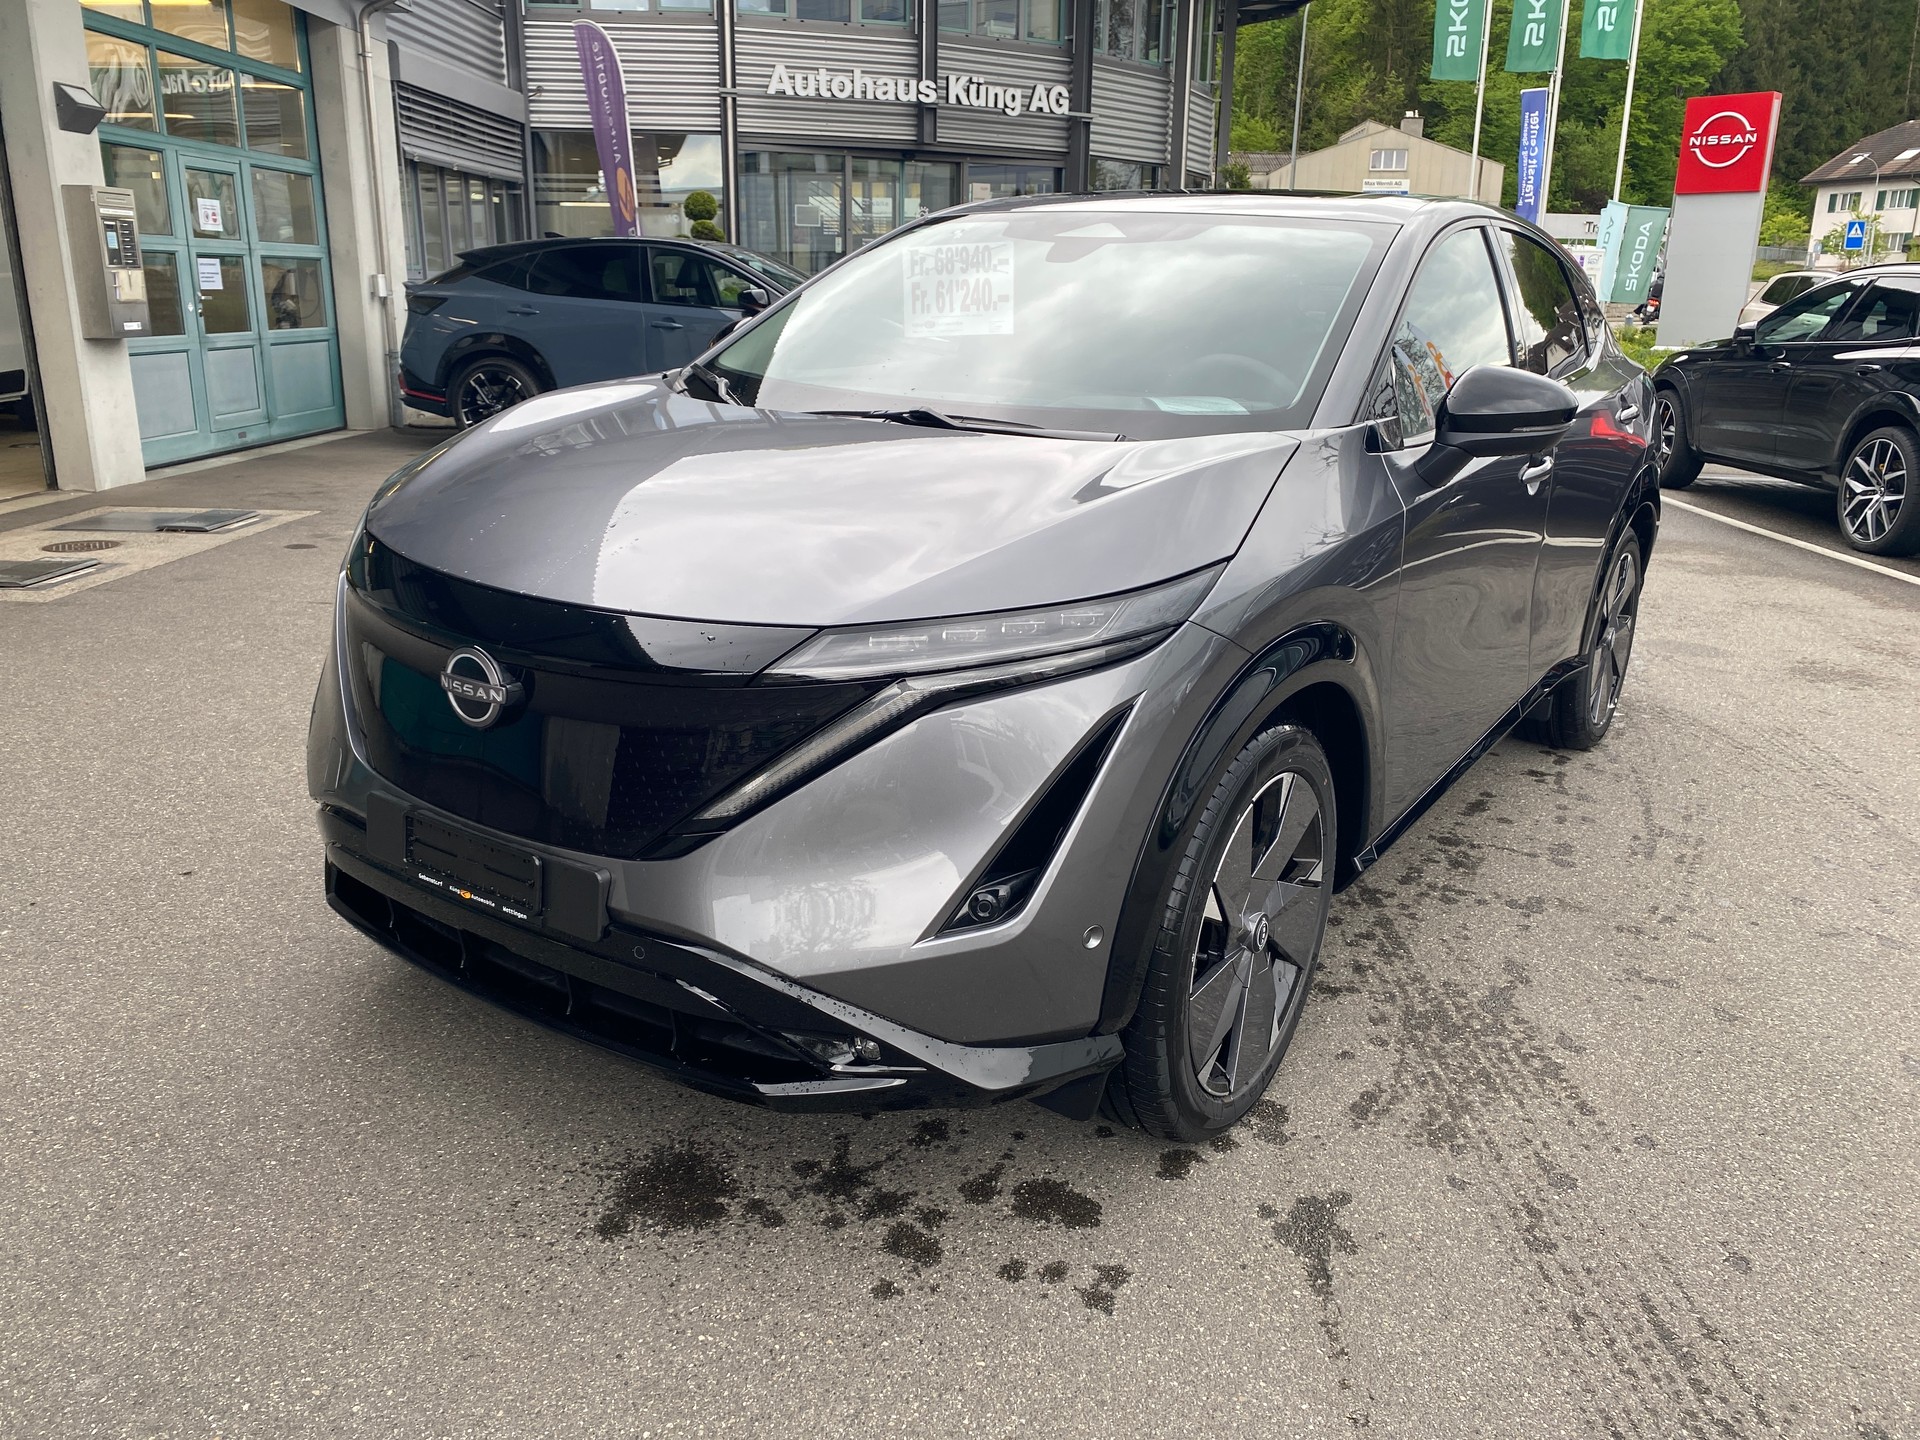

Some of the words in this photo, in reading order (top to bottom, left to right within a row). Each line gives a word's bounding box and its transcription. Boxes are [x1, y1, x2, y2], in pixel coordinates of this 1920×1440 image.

[766, 64, 937, 103] Autohaus
[945, 75, 1022, 117] Küng
[1028, 83, 1070, 115] AG
[1689, 133, 1757, 146] NISSAN
[909, 249, 930, 276] Fr.
[911, 282, 931, 314] Fr.
[441, 674, 503, 702] NISSAN
